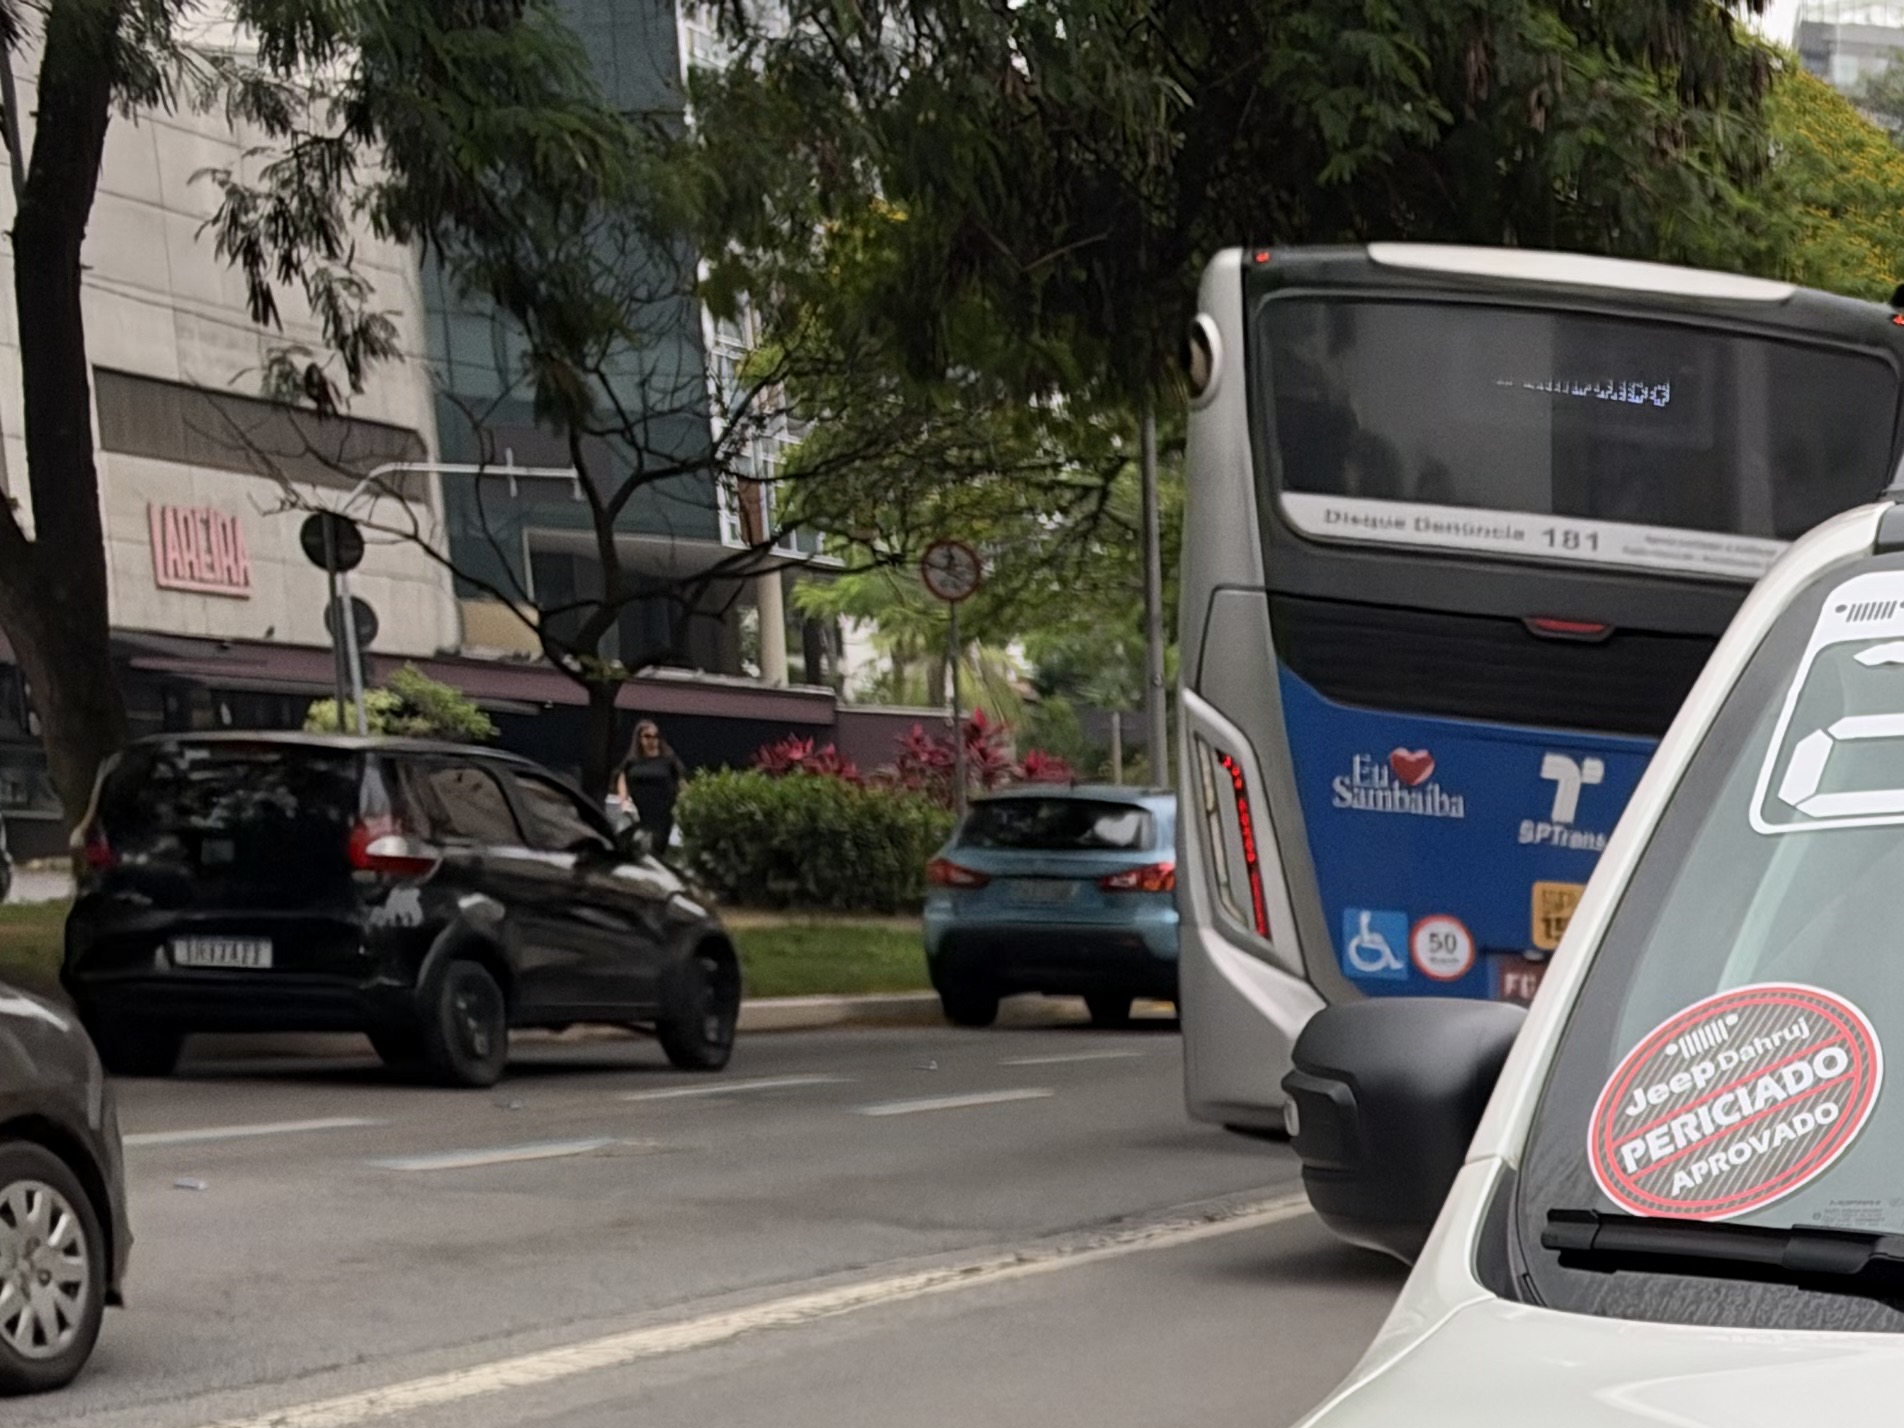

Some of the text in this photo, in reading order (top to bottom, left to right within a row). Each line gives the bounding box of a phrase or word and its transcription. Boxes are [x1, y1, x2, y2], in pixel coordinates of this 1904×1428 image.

[1323, 508, 1406, 531] Disque
[1540, 526, 1601, 553] 181
[1352, 753, 1389, 789] Eu
[1518, 819, 1606, 852] SPTrans
[1428, 931, 1458, 954] 50
[1624, 1016, 1811, 1117] Jeep Dahruj
[1619, 1046, 1849, 1175] PERICIADO
[1671, 1101, 1840, 1197] APROVADO
